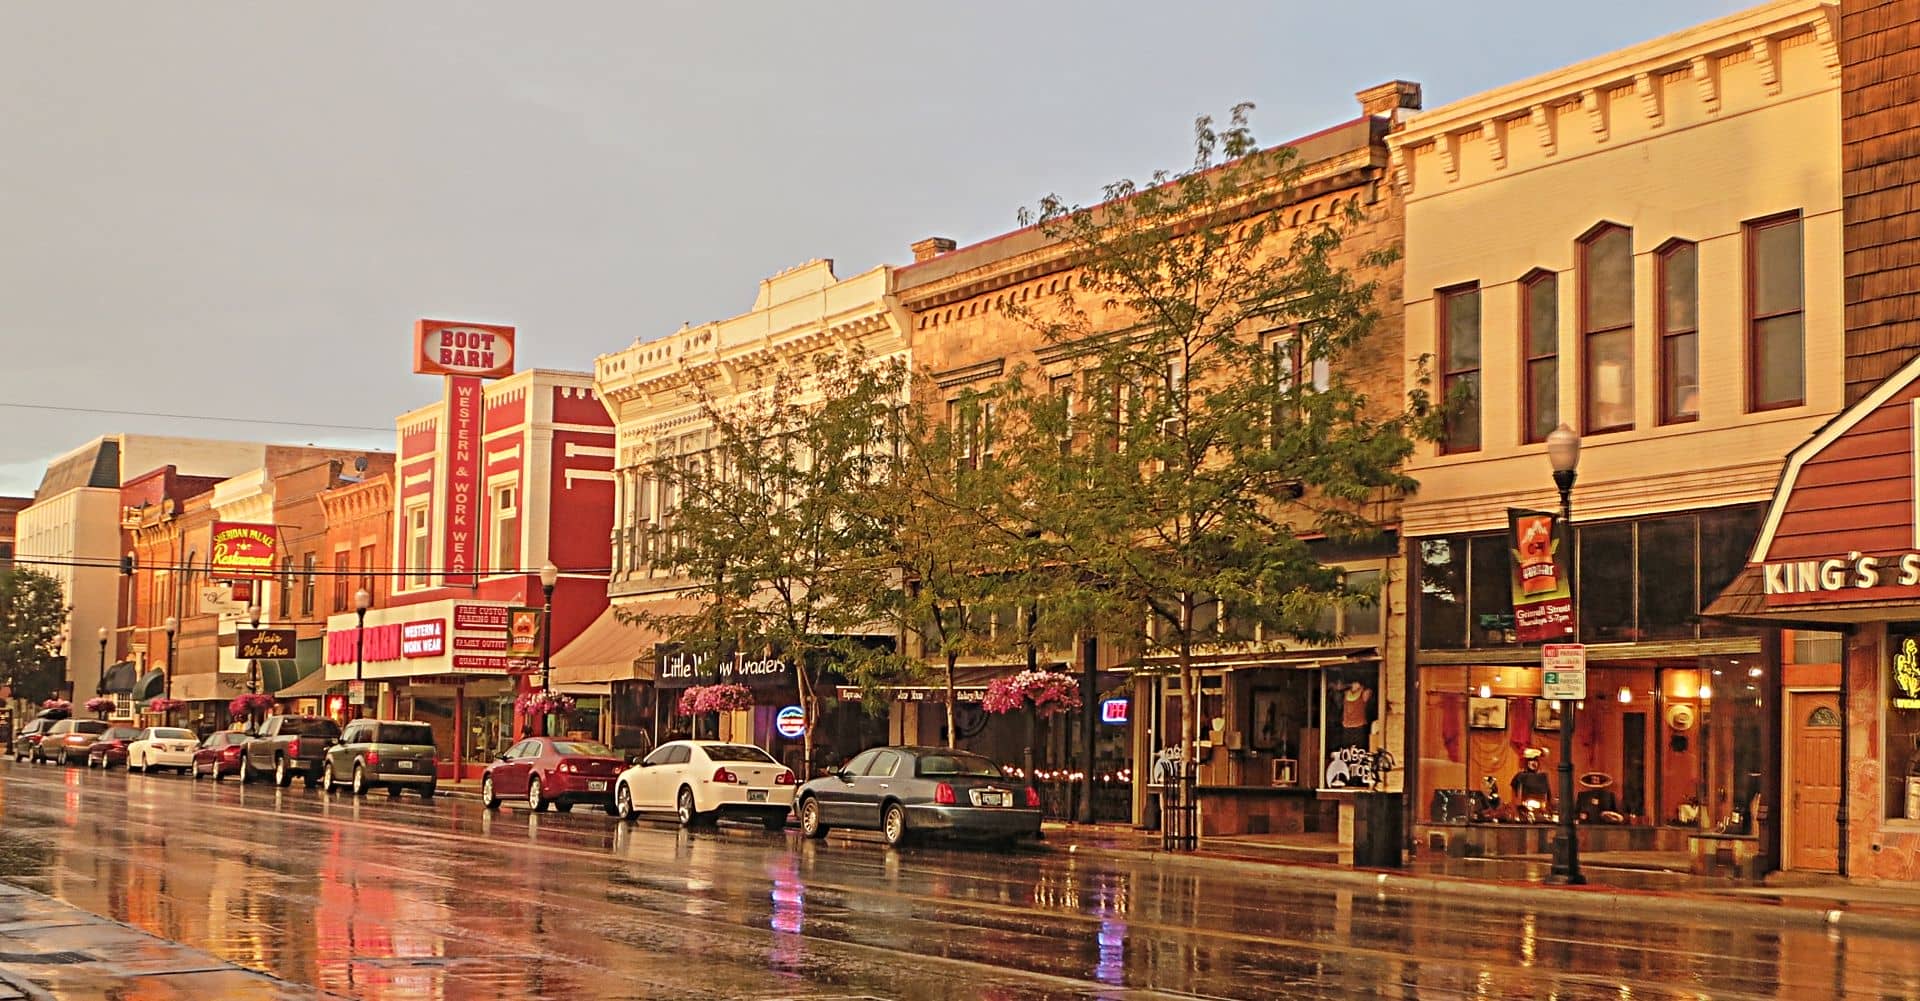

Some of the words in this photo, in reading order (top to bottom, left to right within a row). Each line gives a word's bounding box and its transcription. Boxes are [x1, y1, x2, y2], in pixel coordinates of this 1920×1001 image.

[440, 330, 495, 350] BOOT
[440, 348, 494, 368] BARN
[458, 386, 472, 461] WESTERN
[456, 466, 468, 477] &
[454, 482, 469, 525] WORK
[250, 529, 274, 548] PALACE
[212, 542, 274, 566] Restaurant
[1763, 551, 1879, 594] KING'S
[457, 614, 488, 623] PARKING
[459, 606, 477, 615] FREE
[1546, 604, 1570, 614] Street
[252, 631, 282, 644] Hair
[404, 624, 434, 638] WESTERN
[243, 645, 261, 657] We
[267, 645, 288, 657] Are
[327, 629, 359, 666] BOOT
[363, 623, 402, 663] BARN
[404, 640, 422, 654] WORK
[422, 638, 441, 652] WEAR
[662, 652, 691, 678] Little
[735, 651, 785, 675] Traders
